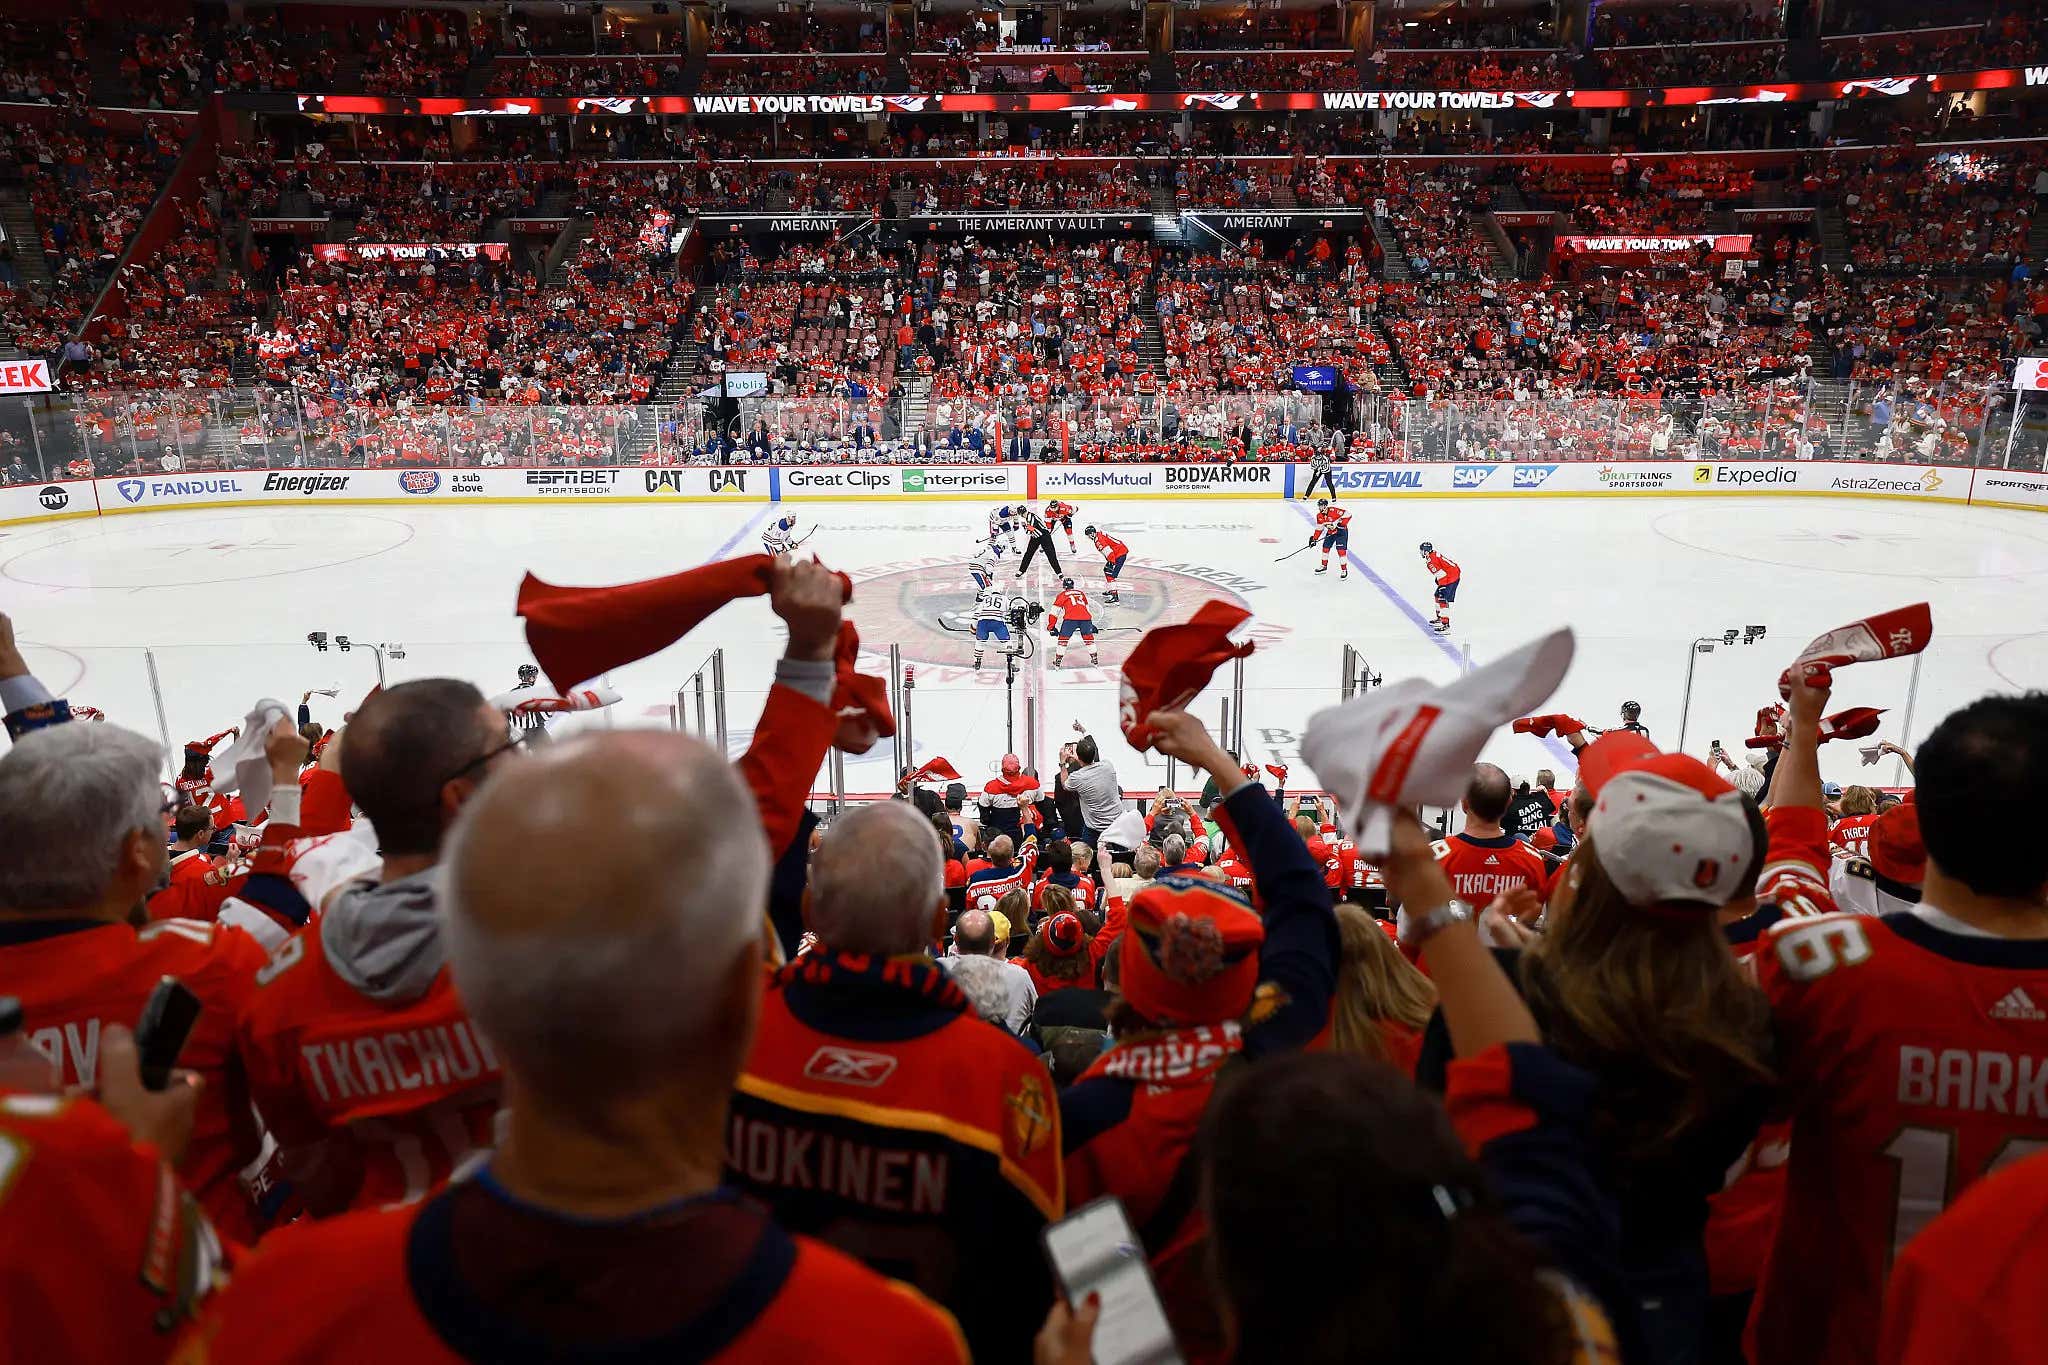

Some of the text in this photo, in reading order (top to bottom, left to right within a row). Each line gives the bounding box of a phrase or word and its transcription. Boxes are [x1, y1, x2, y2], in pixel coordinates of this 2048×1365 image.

[694, 95, 885, 113] WAVE YOUR TOWELS
[1323, 92, 1514, 109] WAVE YOUR TOWELS
[513, 222, 527, 232] 132
[771, 219, 838, 232] AMERANT
[957, 218, 1106, 230] THE AMERANT VAULT
[1223, 216, 1293, 228] AMERANT
[1586, 238, 1624, 251] WAVE
[1625, 238, 1661, 251] YOUR
[390, 247, 428, 258] YOUR
[727, 380, 764, 390] Publix
[452, 472, 481, 483] a sub
[645, 469, 683, 493] CAT
[709, 469, 747, 493] CAT
[788, 470, 891, 491] Great Clips
[908, 473, 1007, 488] enterprise
[1063, 472, 1152, 487] MassMutual
[1165, 466, 1271, 483] BODYARMOR
[1320, 466, 1423, 488] FASTENAL
[1454, 468, 1488, 484] SAP
[1514, 468, 1548, 484] SAP
[1599, 472, 1673, 482] DRAFTKINGS
[1716, 466, 1798, 486] Expedia
[152, 479, 244, 498] FANDUEL
[263, 471, 349, 495] Energizer
[451, 483, 483, 493] above
[1830, 477, 1922, 491] AstraZeneca
[39, 493, 69, 505] TNT
[1518, 801, 1543, 818] BADA
[1517, 819, 1548, 831] SOCIAL
[1522, 810, 1544, 825] BING
[1841, 826, 1870, 840] TKACH
[1453, 871, 1526, 896] TKACHUK
